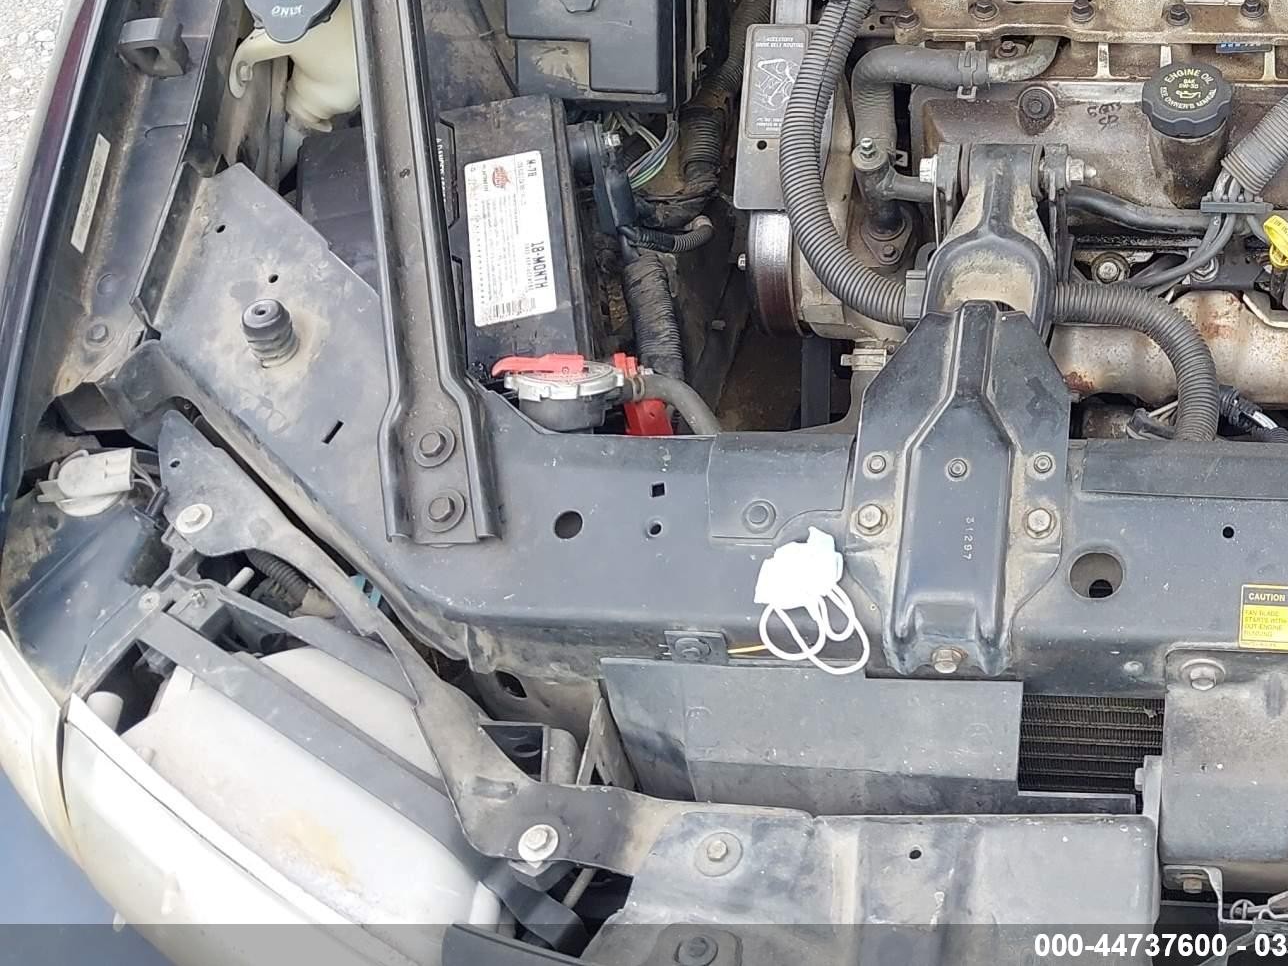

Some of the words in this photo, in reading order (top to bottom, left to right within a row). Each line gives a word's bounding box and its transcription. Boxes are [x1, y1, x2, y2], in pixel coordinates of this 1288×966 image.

[271, 4, 304, 18] ONLY
[1164, 68, 1201, 83] ENGINE
[1200, 72, 1214, 85] OIL
[530, 240, 549, 289] 18-MONTH
[1248, 592, 1286, 602] CAUTION
